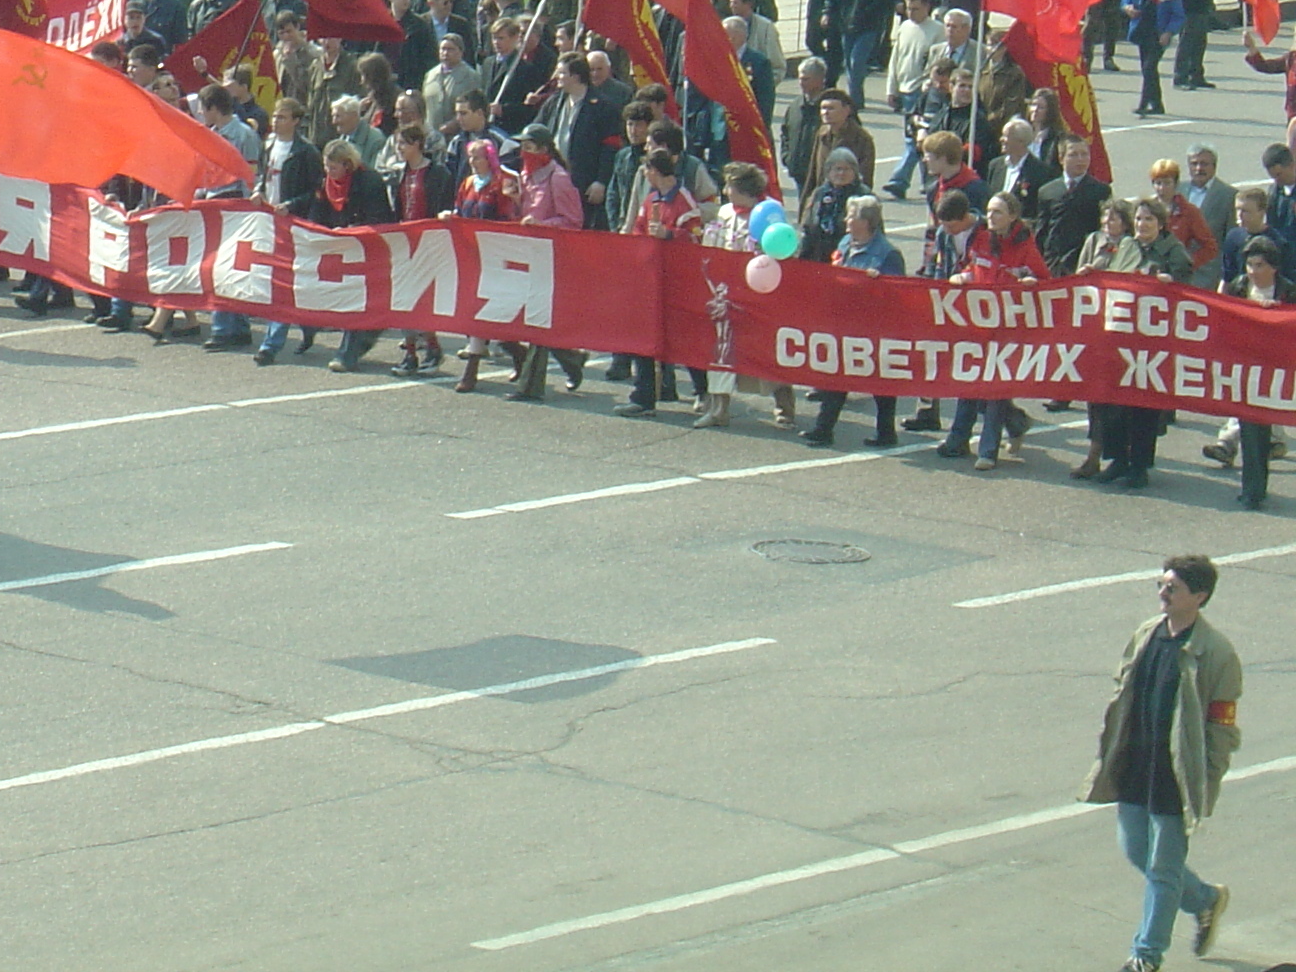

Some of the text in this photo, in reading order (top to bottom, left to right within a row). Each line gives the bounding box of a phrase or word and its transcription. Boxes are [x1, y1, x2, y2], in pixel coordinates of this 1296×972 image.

[88, 196, 553, 328] РОССИЯ
[929, 285, 1209, 342] КОНГРЕСС
[775, 327, 1086, 382] СОВЕТСКИХ
